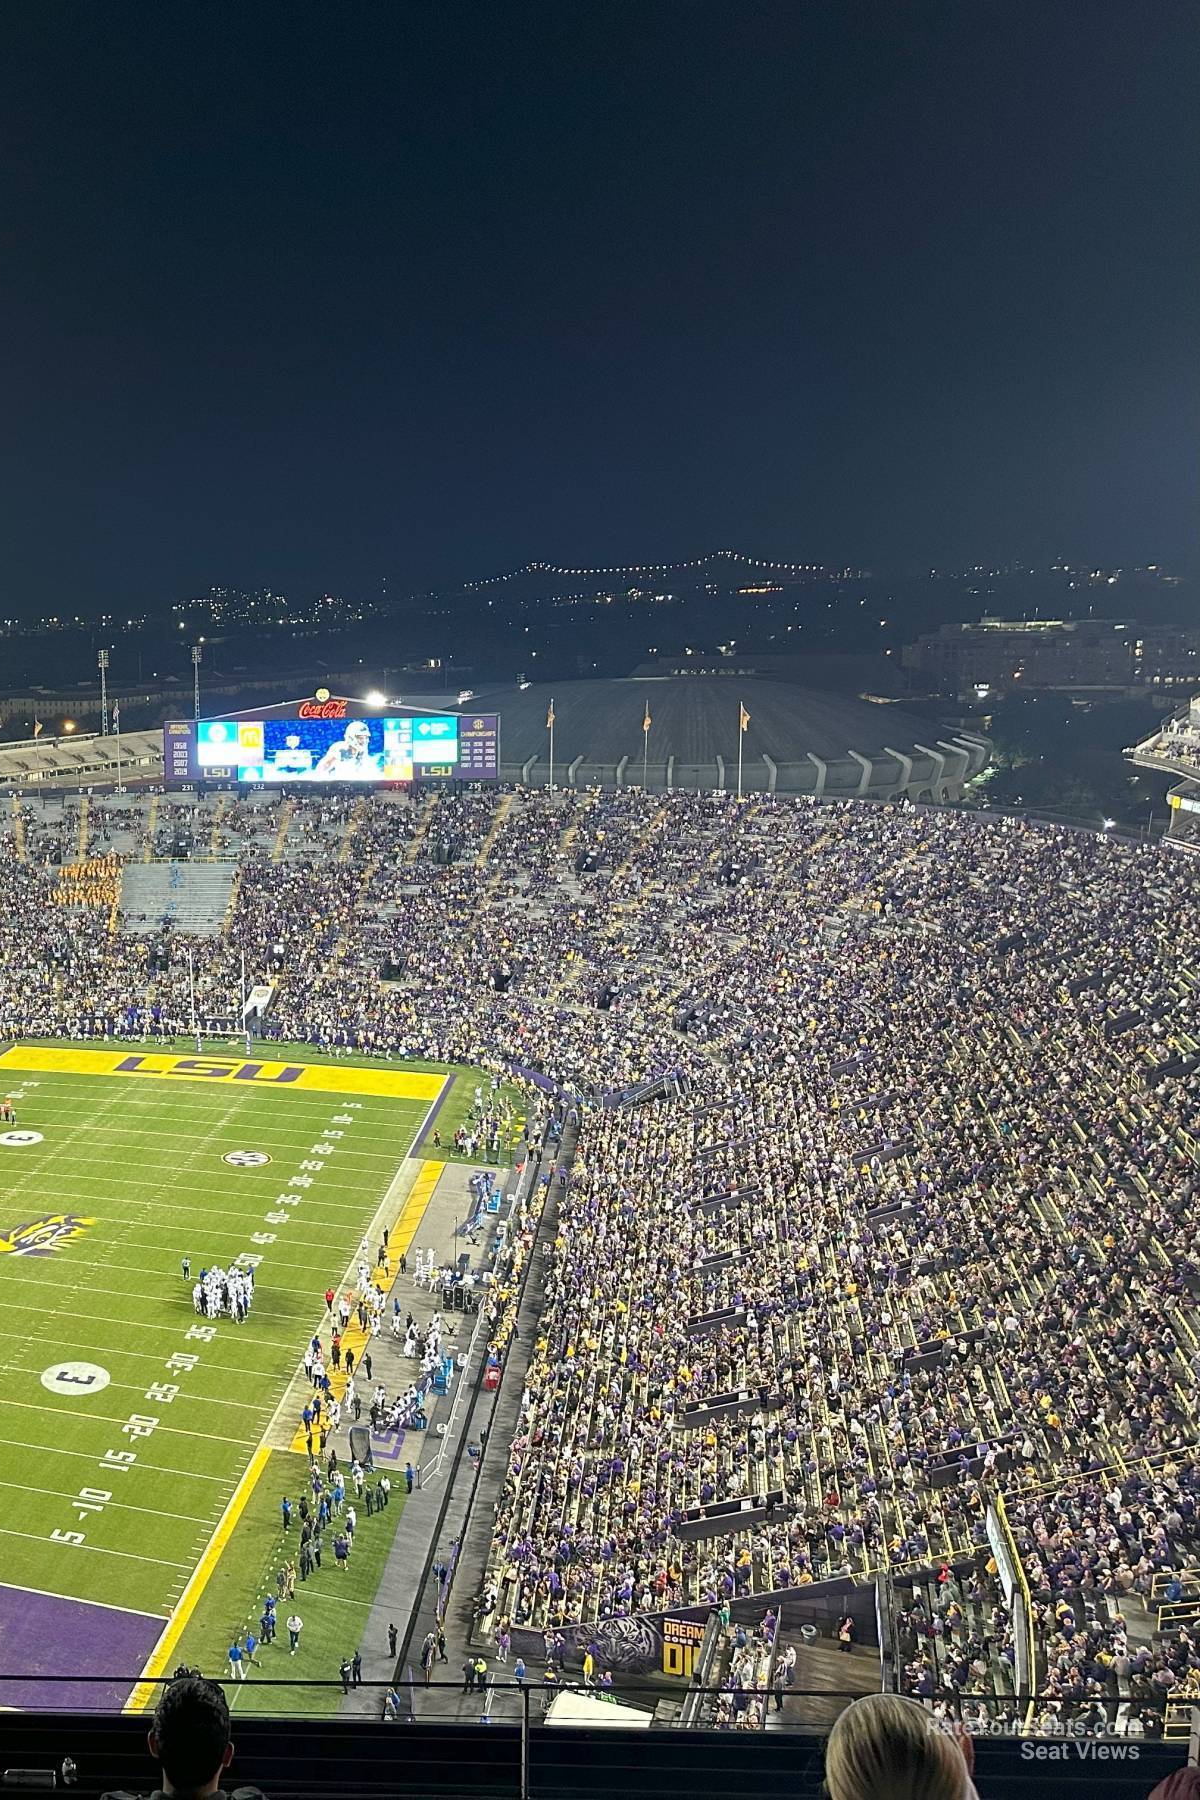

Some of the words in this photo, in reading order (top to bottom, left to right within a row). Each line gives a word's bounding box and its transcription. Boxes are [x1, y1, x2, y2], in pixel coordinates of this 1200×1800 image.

[299, 701, 347, 718] Coca-Cola
[172, 750, 188, 758] 2003
[204, 768, 231, 778] LSU
[421, 766, 452, 776] LSU
[1002, 816, 1016, 826] 241
[1096, 833, 1108, 844] 242
[113, 1056, 305, 1083] LSU
[321, 1130, 344, 1139] 15
[300, 1160, 324, 1170] 25
[288, 1176, 314, 1188] 30
[275, 1194, 302, 1206] 35
[250, 1232, 278, 1244] 45
[184, 1324, 218, 1342] 35
[164, 1352, 200, 1372] 30
[144, 1382, 181, 1404] 25
[122, 1414, 160, 1436] 20
[99, 1449, 138, 1472] 15
[72, 1487, 112, 1512] 10
[50, 1528, 86, 1544] 5
[664, 1622, 705, 1640] DREAM
[664, 1634, 694, 1646] COME
